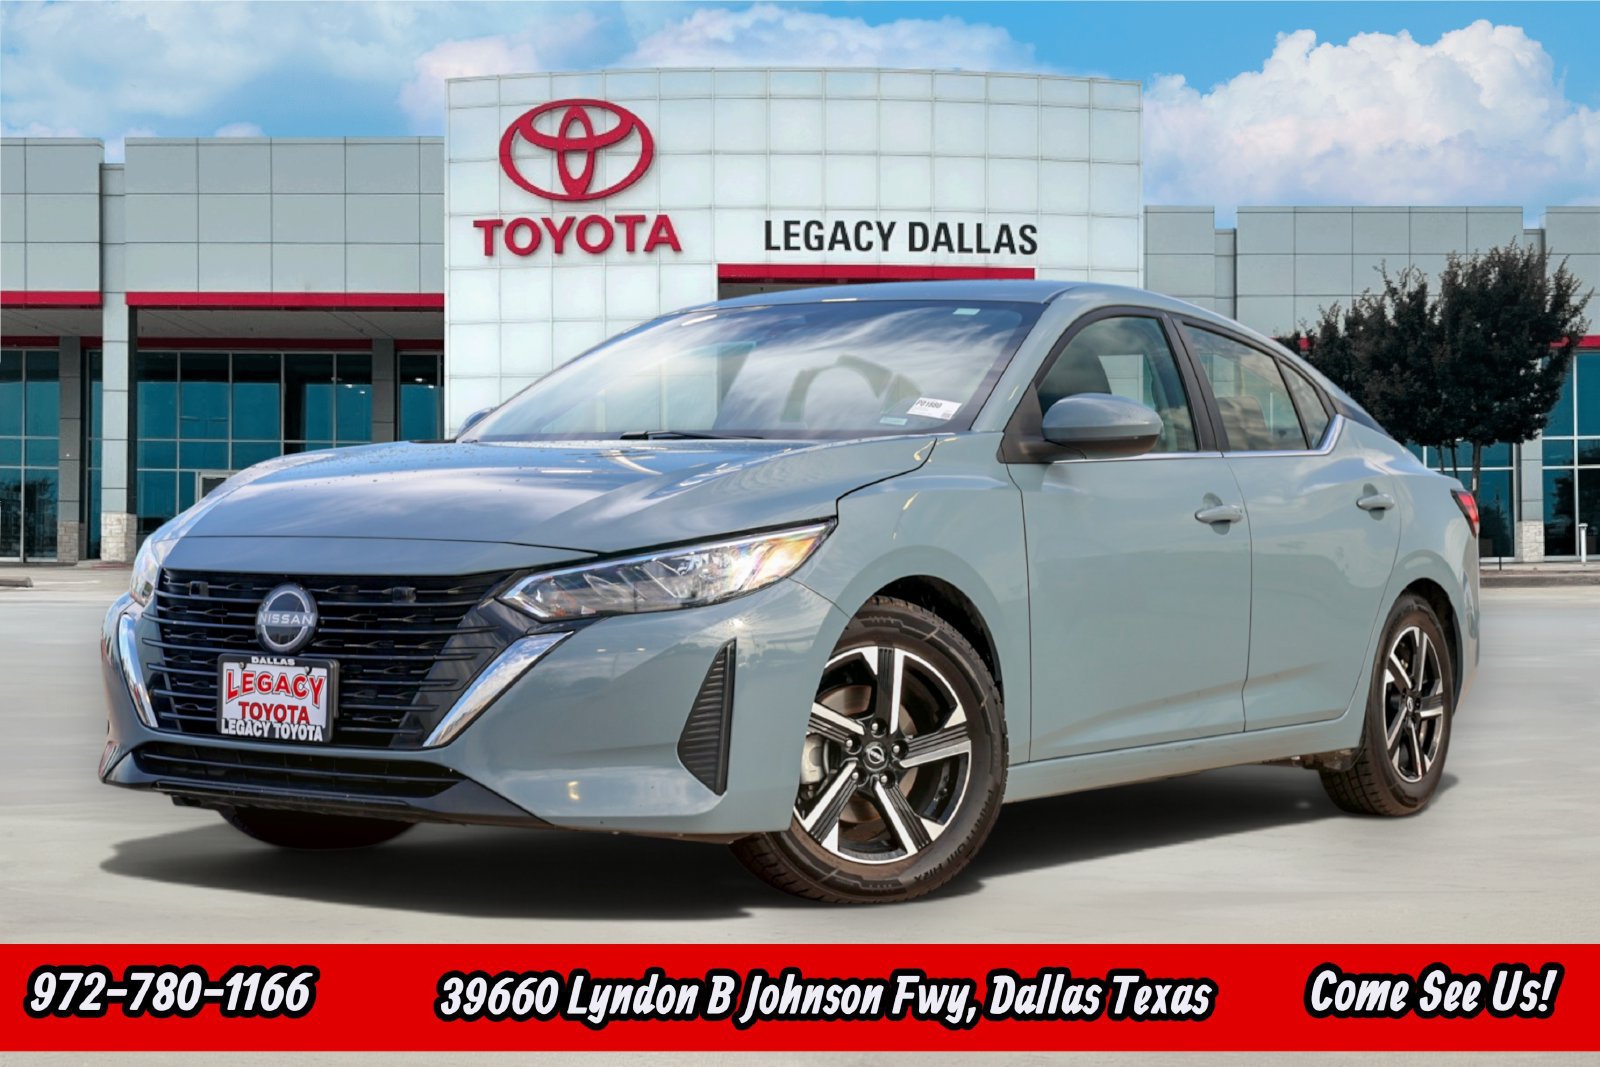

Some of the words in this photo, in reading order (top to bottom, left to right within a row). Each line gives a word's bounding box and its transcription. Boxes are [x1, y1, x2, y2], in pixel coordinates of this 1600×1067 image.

[474, 213, 682, 257] TOYOTA
[764, 220, 896, 252] LEGACY
[908, 221, 1038, 255] DALLAS
[257, 612, 314, 625] NISSAN
[251, 655, 296, 666] DALLAS
[226, 669, 326, 708] LEGACY
[238, 701, 310, 725] TOYOTA
[221, 718, 271, 736] LEGACY
[273, 722, 323, 742] TOYOTA
